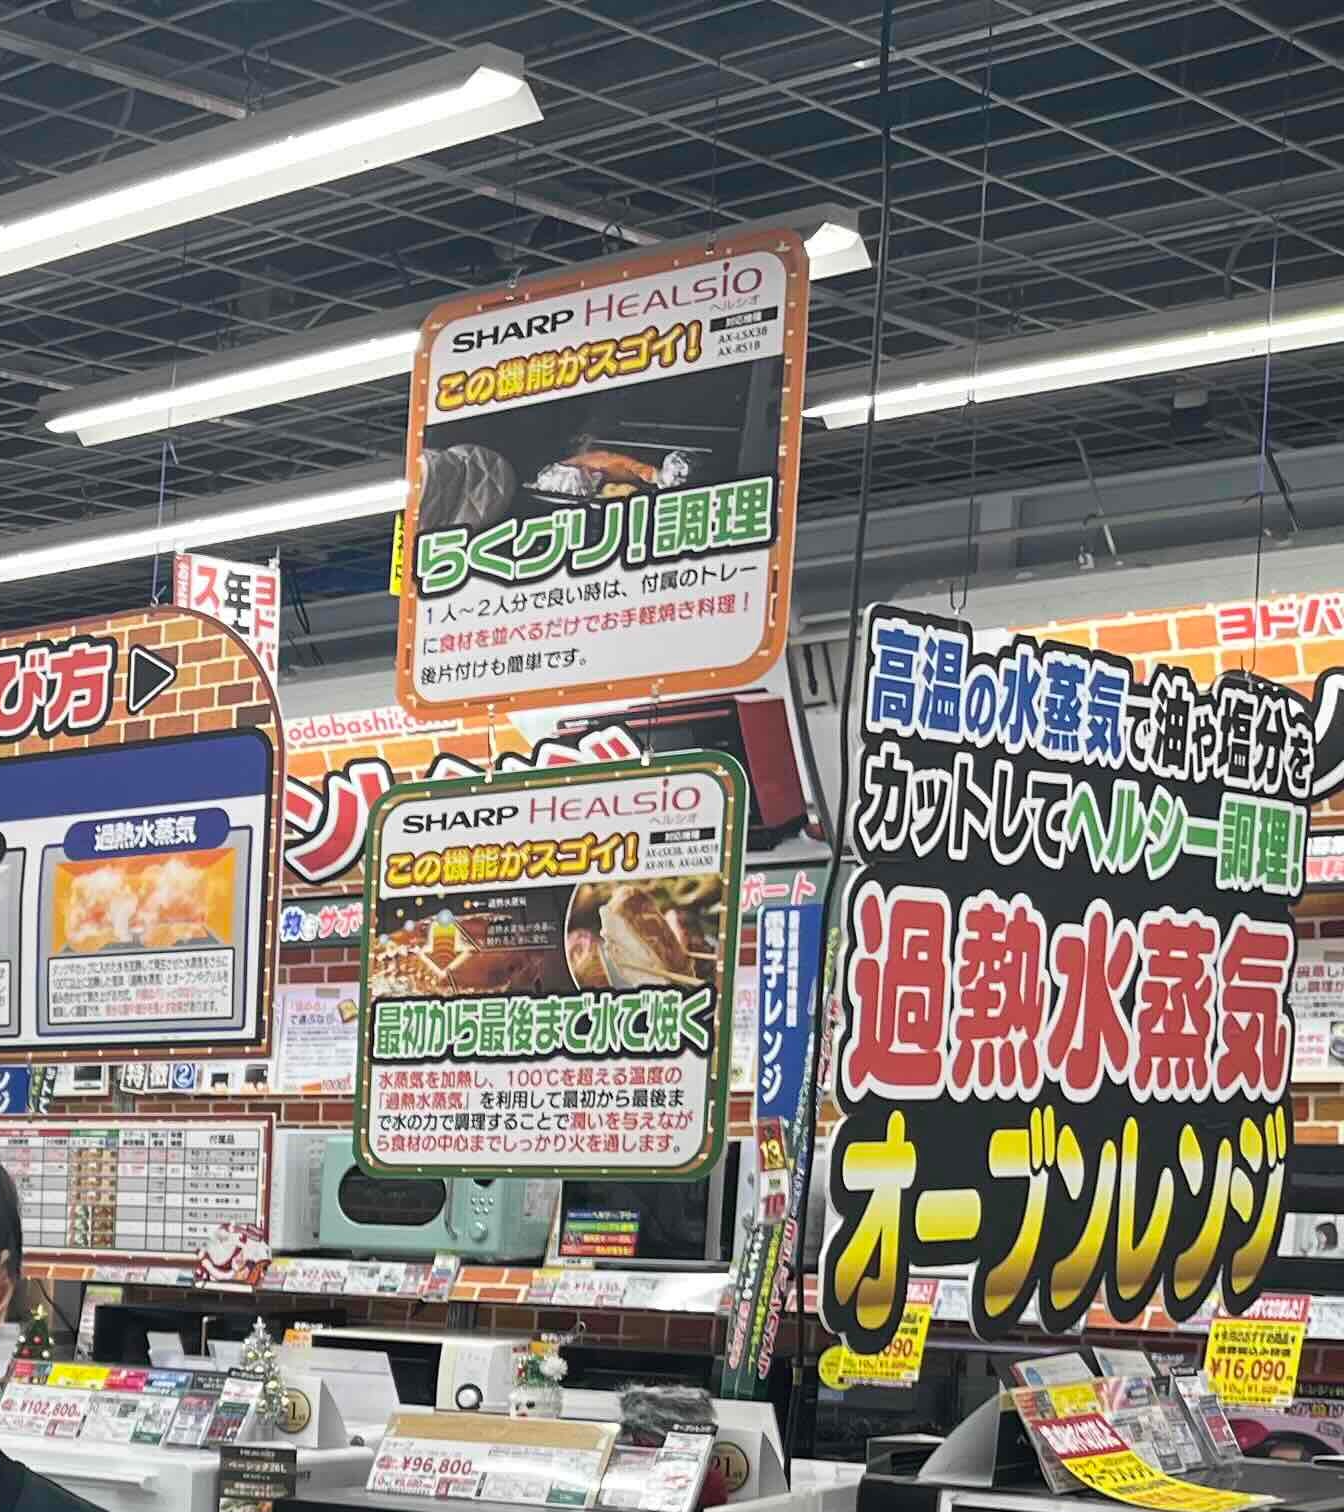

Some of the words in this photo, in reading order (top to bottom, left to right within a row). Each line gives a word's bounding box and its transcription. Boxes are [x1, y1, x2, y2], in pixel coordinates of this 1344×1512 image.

[452, 309, 574, 353] SHARP
[436, 320, 703, 412] この機能がスゴイ!
[421, 648, 588, 686] 後片付けも簡単です。
[866, 615, 1315, 800] 高温の水蒸気で油や塩分を
[94, 815, 197, 851] 過熱水蒸気
[402, 804, 519, 834] SHARP
[859, 740, 1309, 898] カットしてヘルシー調理!
[385, 832, 639, 888] この機能がスゴイ!
[843, 879, 1295, 1104] 過熱水蒸気
[373, 990, 711, 1060] 最初から最後まで水で焼く
[834, 1104, 1287, 1330] オーブンレンジ
[1210, 1358, 1287, 1382] ¥16,090
[401, 1456, 474, 1476] ¥96,800
